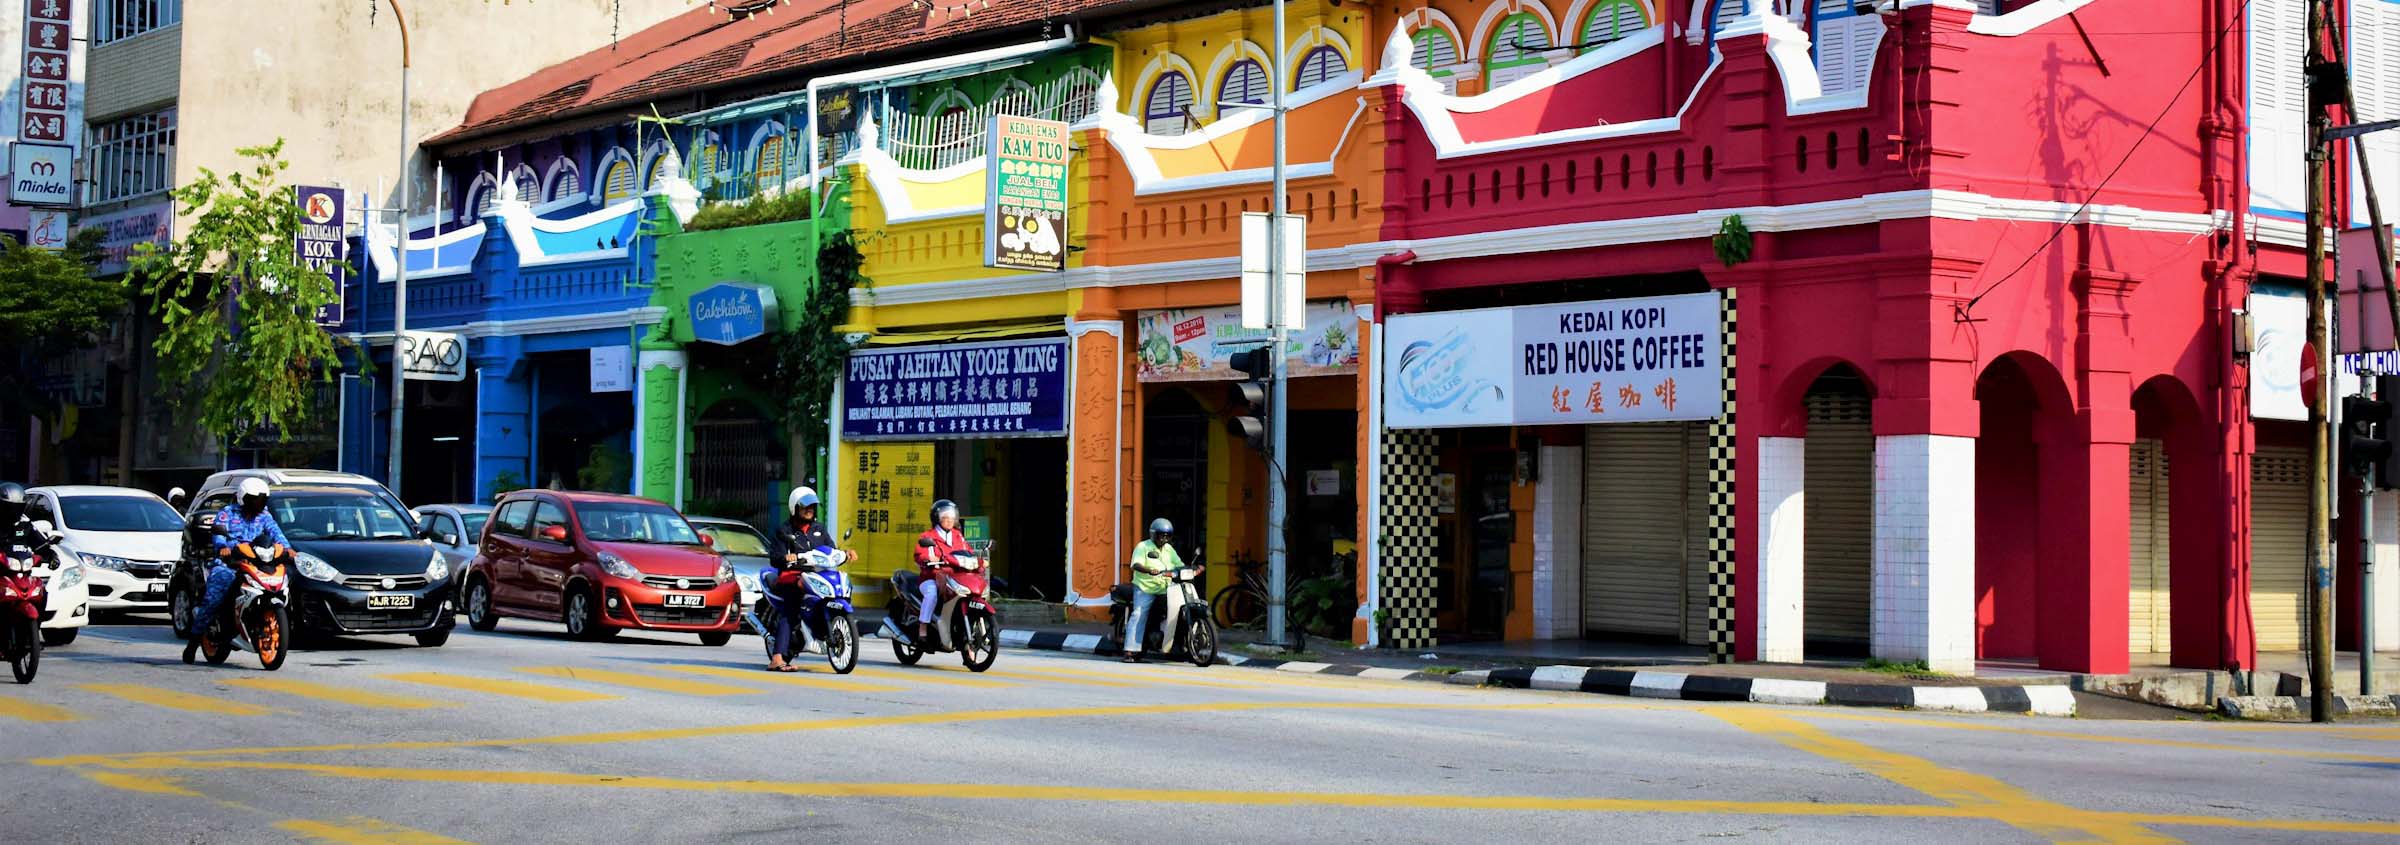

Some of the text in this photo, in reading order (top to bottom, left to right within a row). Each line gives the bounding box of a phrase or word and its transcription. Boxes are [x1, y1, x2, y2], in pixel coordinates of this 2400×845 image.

[1009, 122, 1058, 138] KEDAI EMAS
[1003, 137, 1063, 160] KAM TUO
[1007, 176, 1058, 189] JUAL BELI
[309, 196, 329, 218] K
[304, 241, 334, 257] KOK
[1560, 308, 1665, 333] KEDAI KOPI
[850, 345, 1058, 381] PUSAT JAHITAN YOOH MING
[1525, 334, 1704, 375] RED HOUSE COFFEE
[1551, 377, 1677, 414] 紅屋咖啡
[859, 451, 880, 474] 車字
[857, 479, 890, 504] 學生牌
[373, 597, 410, 606] AJR 7225
